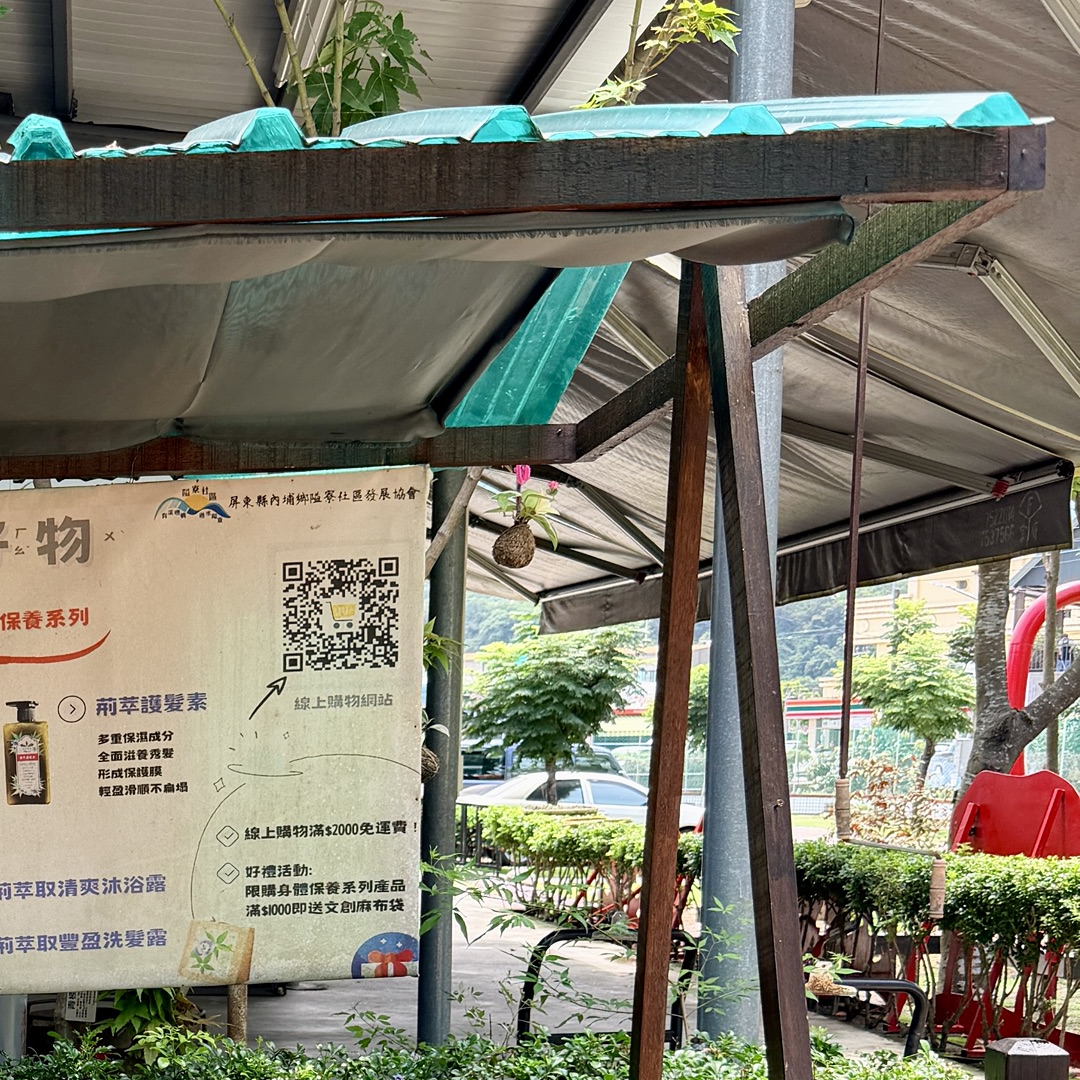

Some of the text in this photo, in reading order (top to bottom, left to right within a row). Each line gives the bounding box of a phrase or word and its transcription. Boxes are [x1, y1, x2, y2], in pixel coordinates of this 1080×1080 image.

[95, 692, 208, 717] 荊萃護髮素
[294, 693, 394, 711] 線上購物網站
[97, 730, 175, 746] 多重保濕成分
[97, 747, 175, 763] 全面滋養秀髮
[97, 765, 163, 780] 形成保護膜
[98, 781, 189, 798] 輕盈滑順不扁塌
[245, 879, 406, 898] 限購身體保養系列產品
[245, 898, 405, 918] 滿$1000即送文創麻布袋
